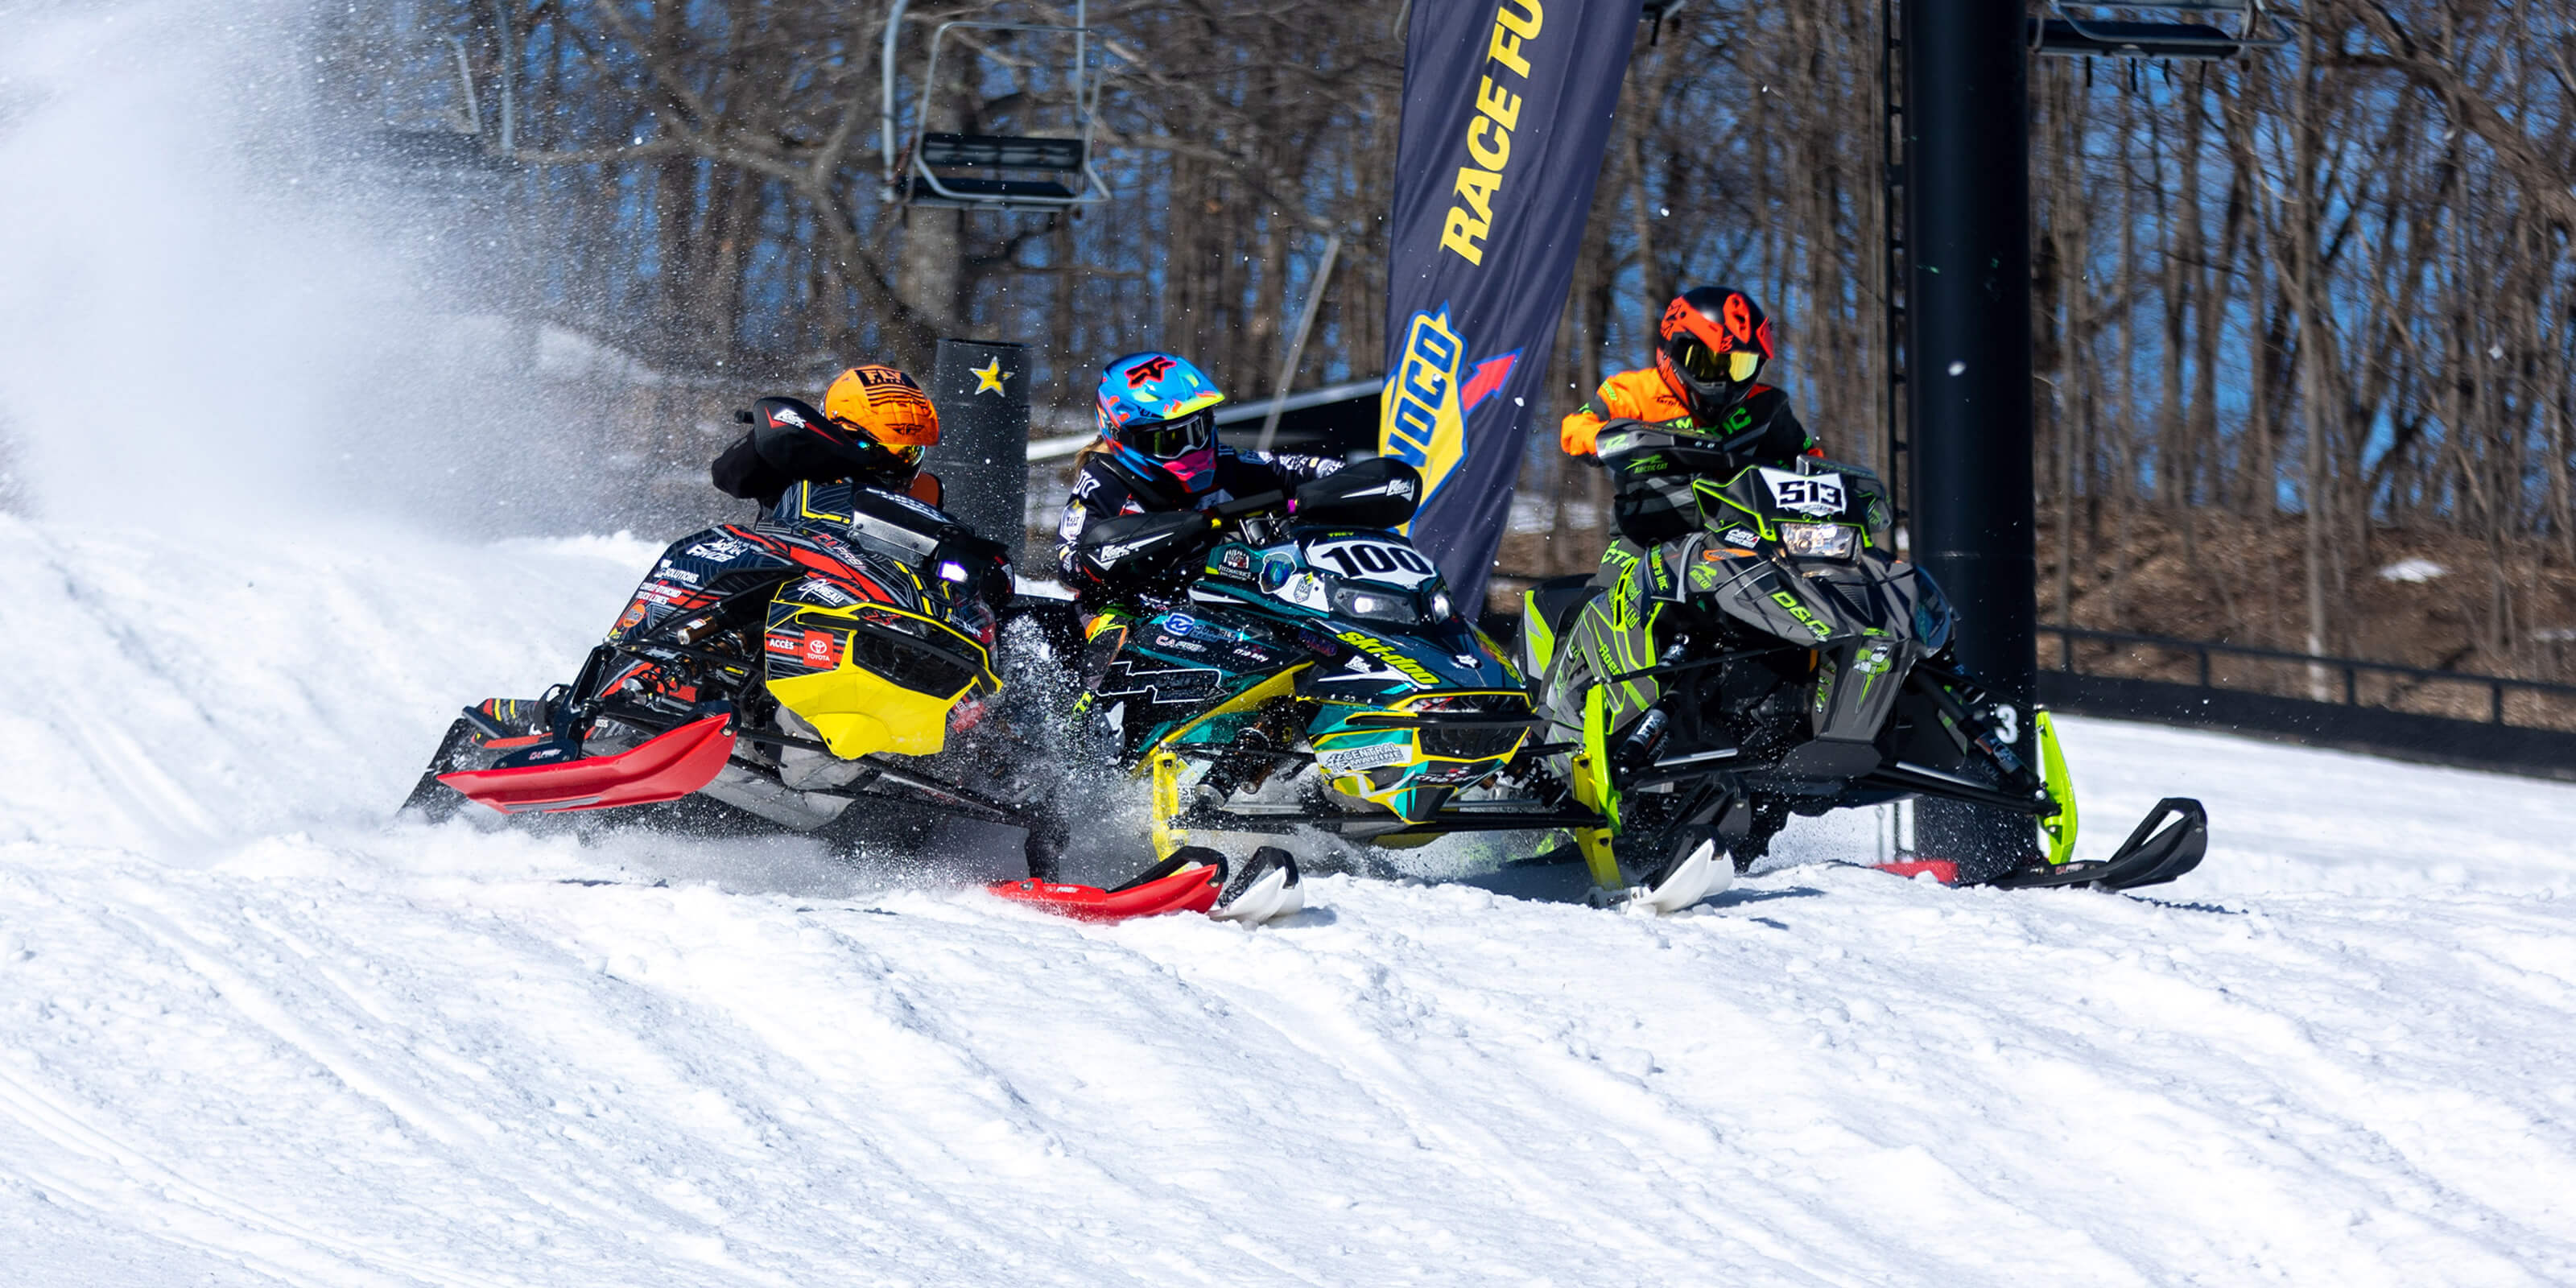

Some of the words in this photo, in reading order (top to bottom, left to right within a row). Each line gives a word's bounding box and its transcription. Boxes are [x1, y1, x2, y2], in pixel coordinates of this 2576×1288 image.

[1439, 74, 1522, 266] RACE
[865, 369, 902, 382] FLY
[1384, 322, 1456, 468] NOCO
[1777, 480, 1842, 508] 513
[1320, 544, 1434, 578] 100
[666, 568, 700, 584] SOLUTIONS
[769, 638, 795, 650] ACCÈS
[807, 653, 831, 663] TOYOTA
[1995, 704, 2018, 745] 3
[1344, 744, 1399, 761] CENTRAL
[1349, 750, 1404, 767] MARINE
